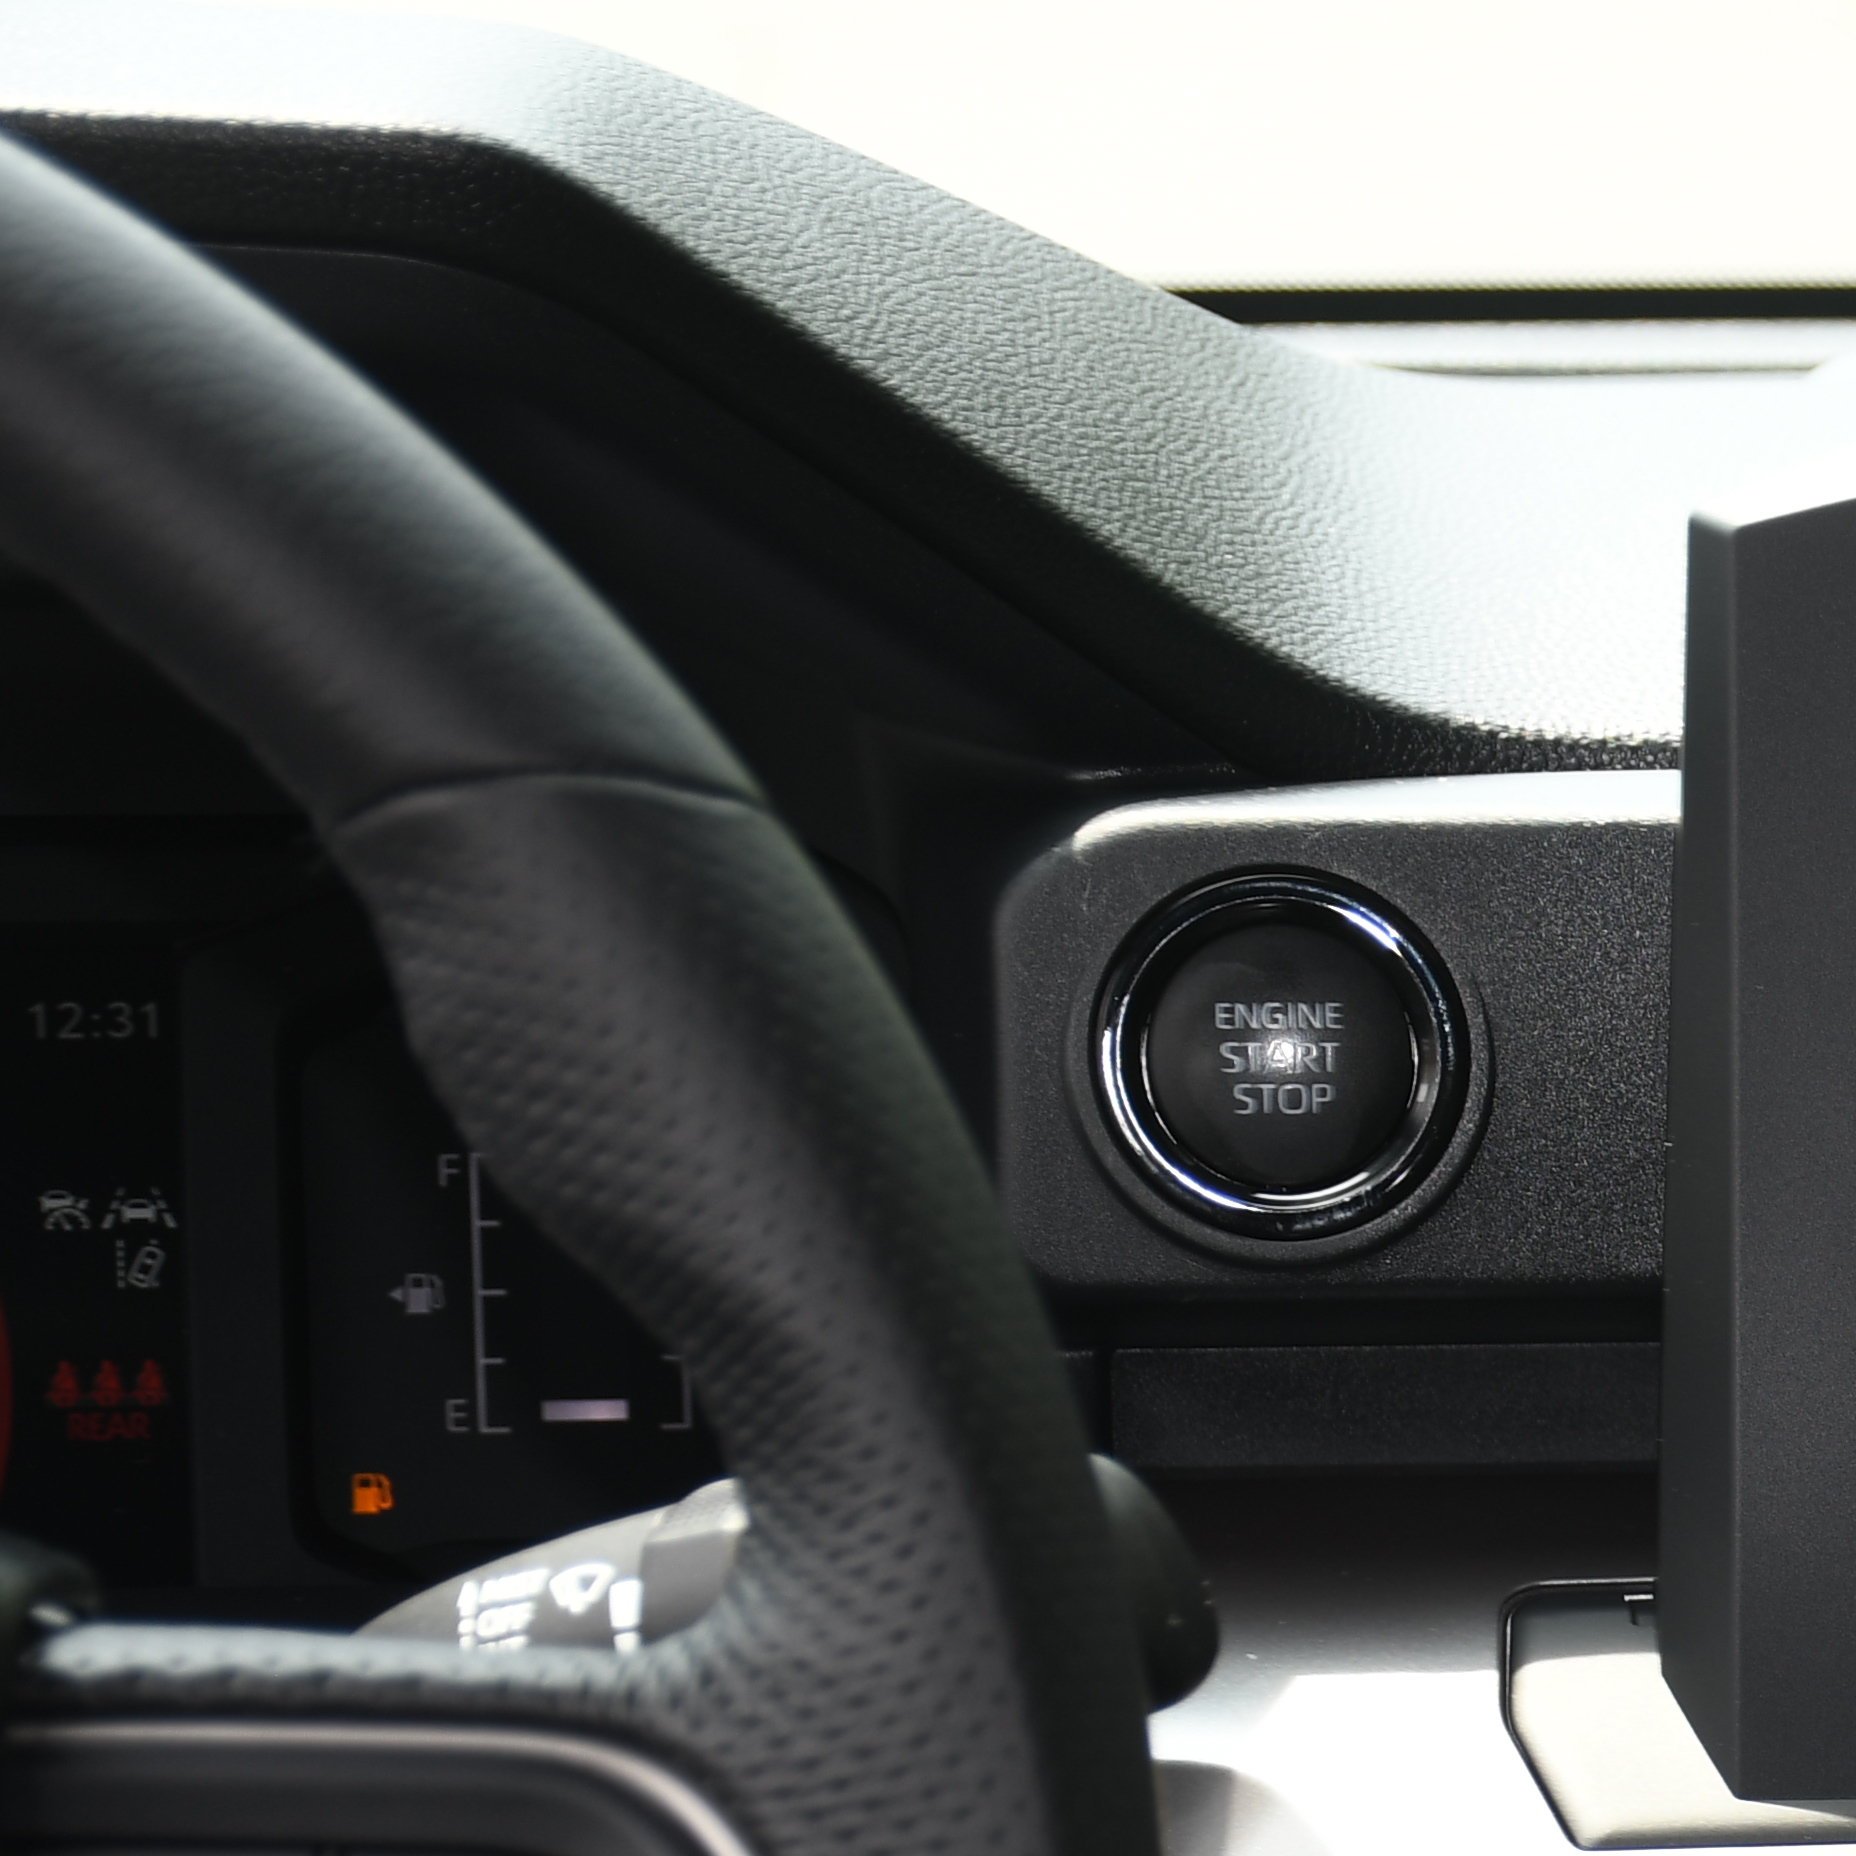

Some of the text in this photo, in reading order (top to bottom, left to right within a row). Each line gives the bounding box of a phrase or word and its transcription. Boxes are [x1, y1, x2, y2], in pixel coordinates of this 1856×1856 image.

[26, 1001, 159, 1040] 12:31
[1215, 1002, 1344, 1030] ENGINE
[1218, 1040, 1341, 1074] START
[1233, 1083, 1335, 1115] STOP
[438, 1153, 459, 1186] F
[445, 1398, 469, 1432] E
